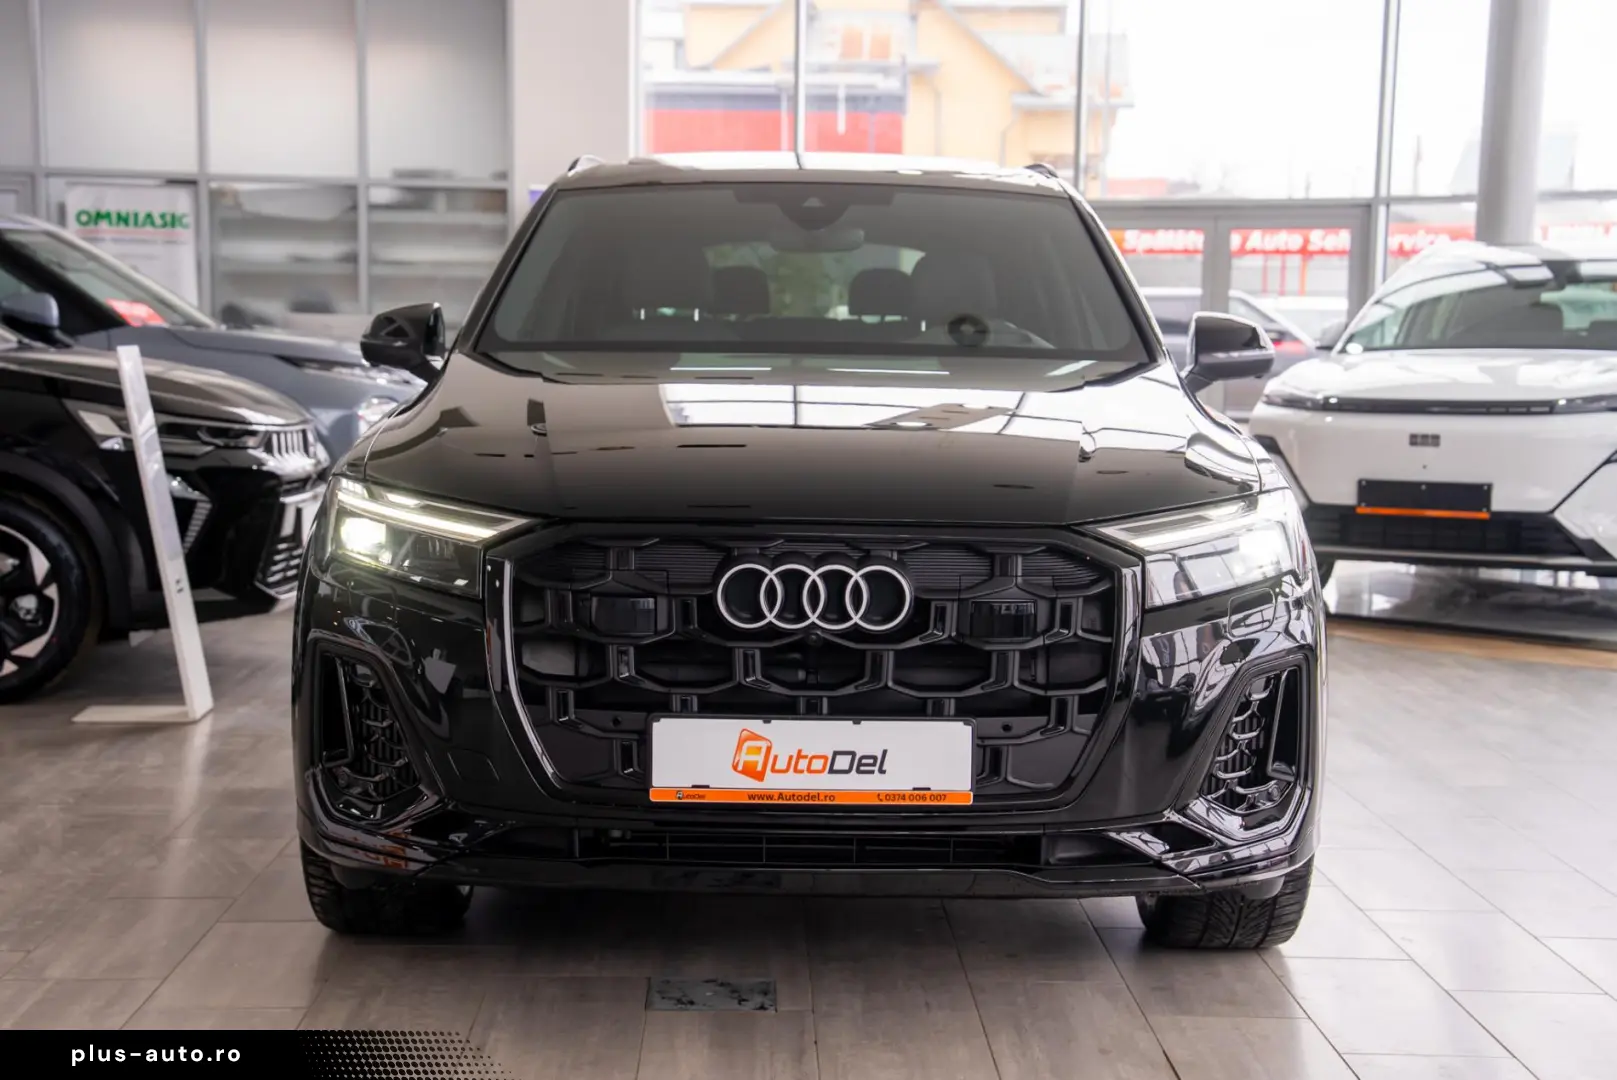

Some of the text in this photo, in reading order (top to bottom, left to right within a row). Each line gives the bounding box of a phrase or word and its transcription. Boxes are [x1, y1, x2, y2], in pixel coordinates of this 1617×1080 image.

[1245, 229, 1304, 252] Auto
[1307, 229, 1351, 252] Sel
[732, 728, 888, 783] AutoDel
[747, 792, 836, 802] www.Autodel.ro
[884, 793, 947, 802] 0374 006 007
